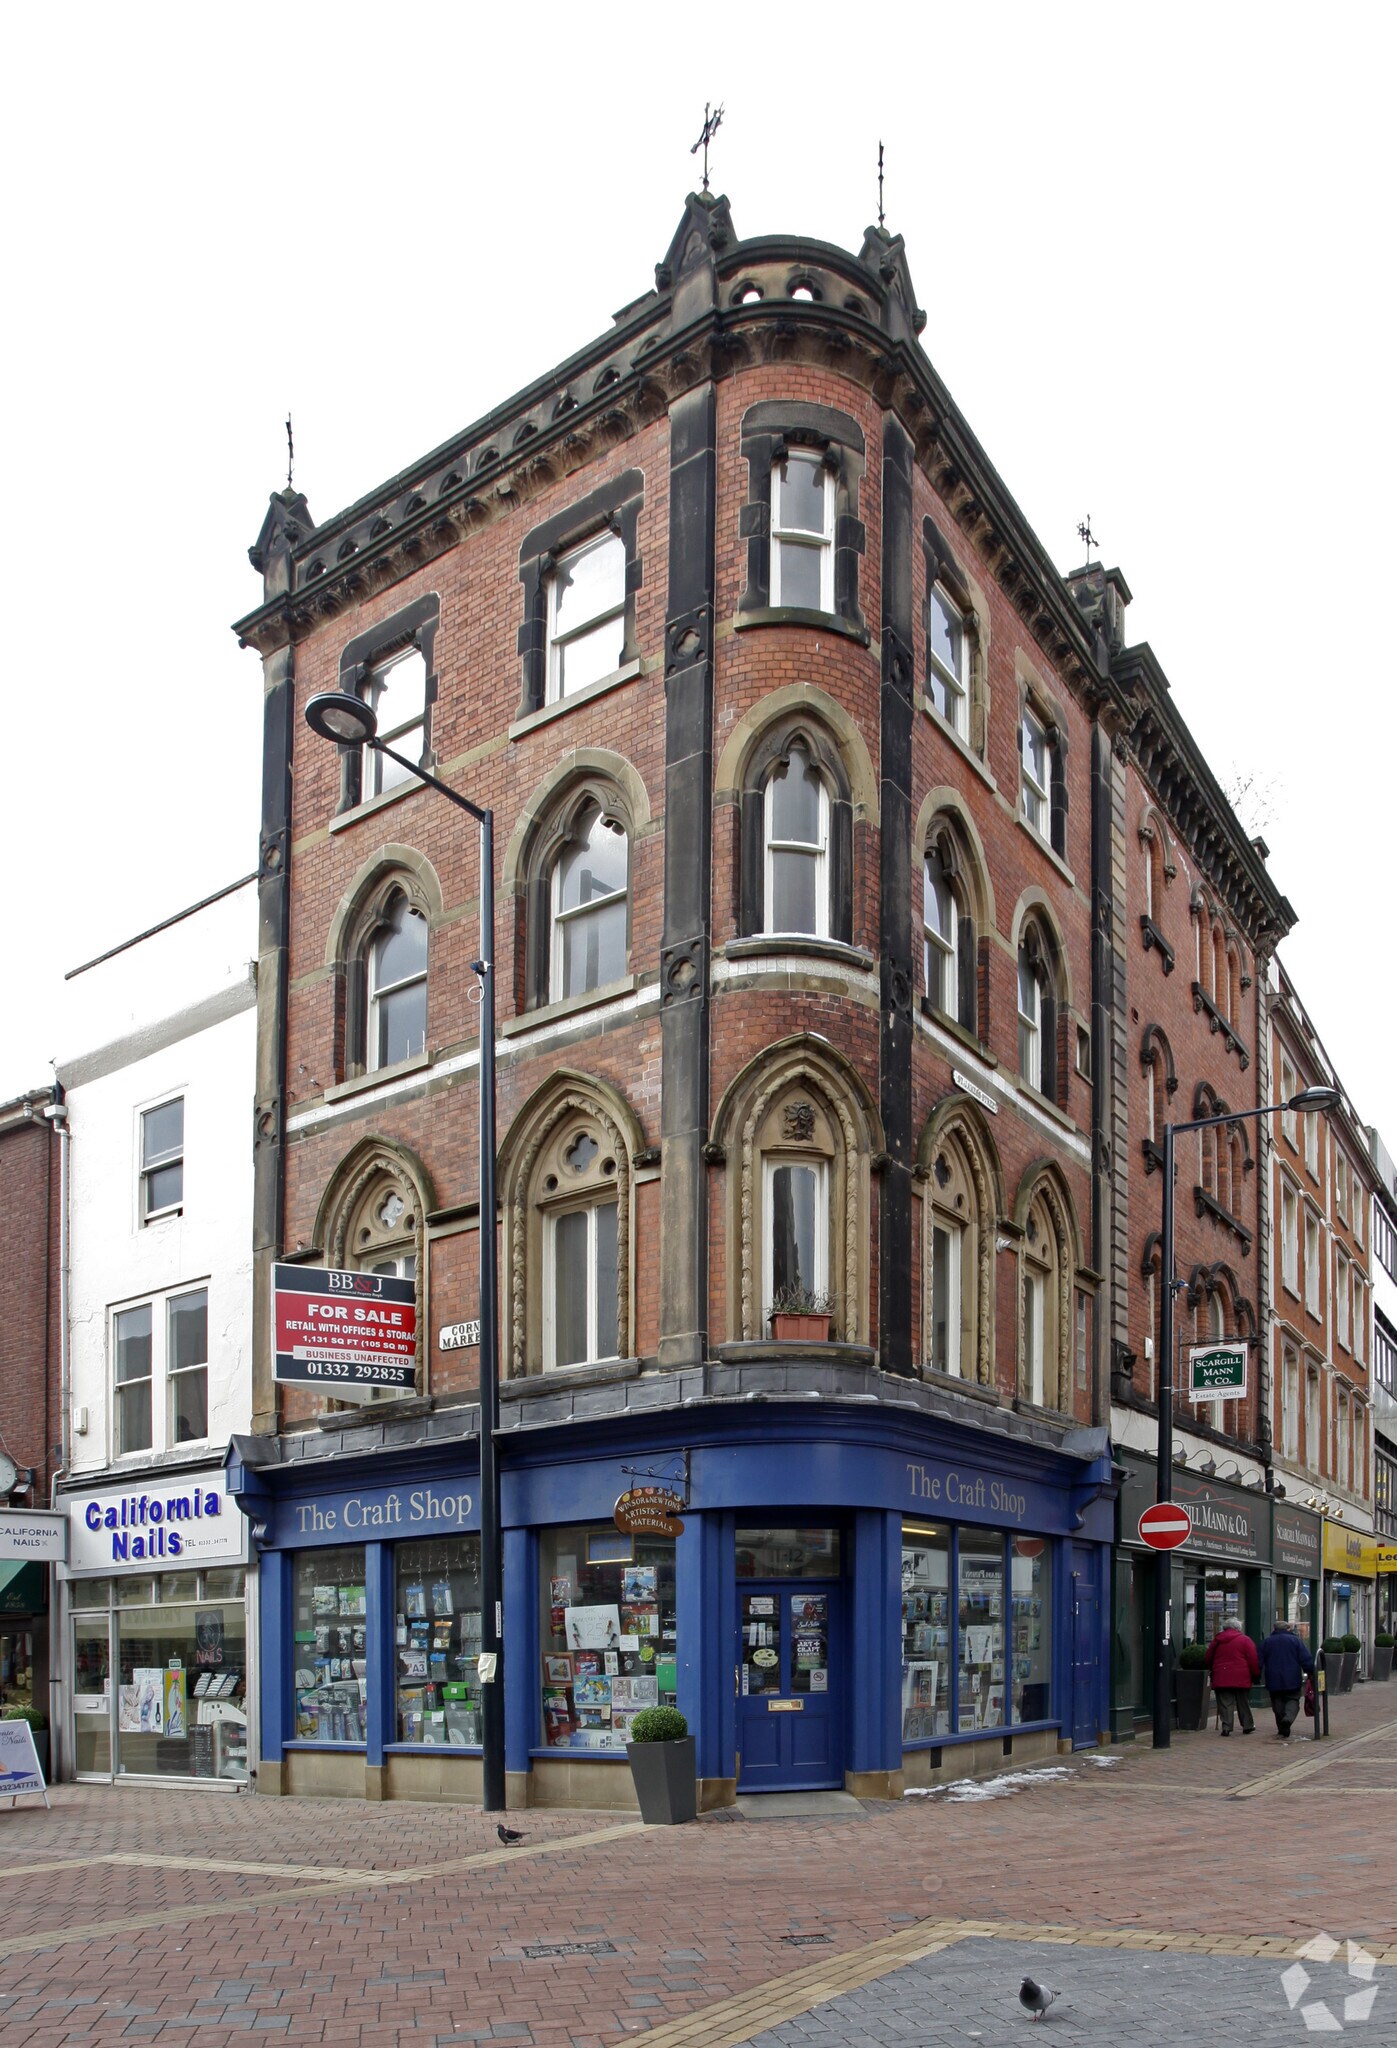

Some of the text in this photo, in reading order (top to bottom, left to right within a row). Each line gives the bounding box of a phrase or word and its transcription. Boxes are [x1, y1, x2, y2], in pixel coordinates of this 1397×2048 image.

[308, 1304, 402, 1325] FOR SALE
[286, 1320, 416, 1342] RETAIL WITH OFFICES & STORAG
[452, 1322, 480, 1336] CORN
[302, 1335, 328, 1344] 1,131
[361, 1340, 378, 1348] (105
[398, 1343, 408, 1352] M)
[442, 1332, 480, 1348] MARKE
[306, 1350, 409, 1365] BUSINESS UNAFFECTED
[1196, 1357, 1241, 1368] SCARGILL
[307, 1362, 405, 1381] 01332 292825
[1203, 1367, 1234, 1377] MANN
[1217, 1390, 1240, 1398] Agents
[906, 1464, 1025, 1521] The Craft Shop
[85, 1488, 221, 1532] California
[296, 1490, 472, 1532] The Craft Shop
[631, 1518, 673, 1532] MATERIALS
[1202, 1506, 1228, 1532] MANN
[1228, 1517, 1235, 1534] &
[13, 1538, 40, 1547] NAILS
[112, 1526, 183, 1562] Nails
[185, 1539, 196, 1547] TEL
[1378, 1553, 1397, 1561] Lee
[196, 1648, 222, 1664] NAILS
[412, 1664, 425, 1672] A3
